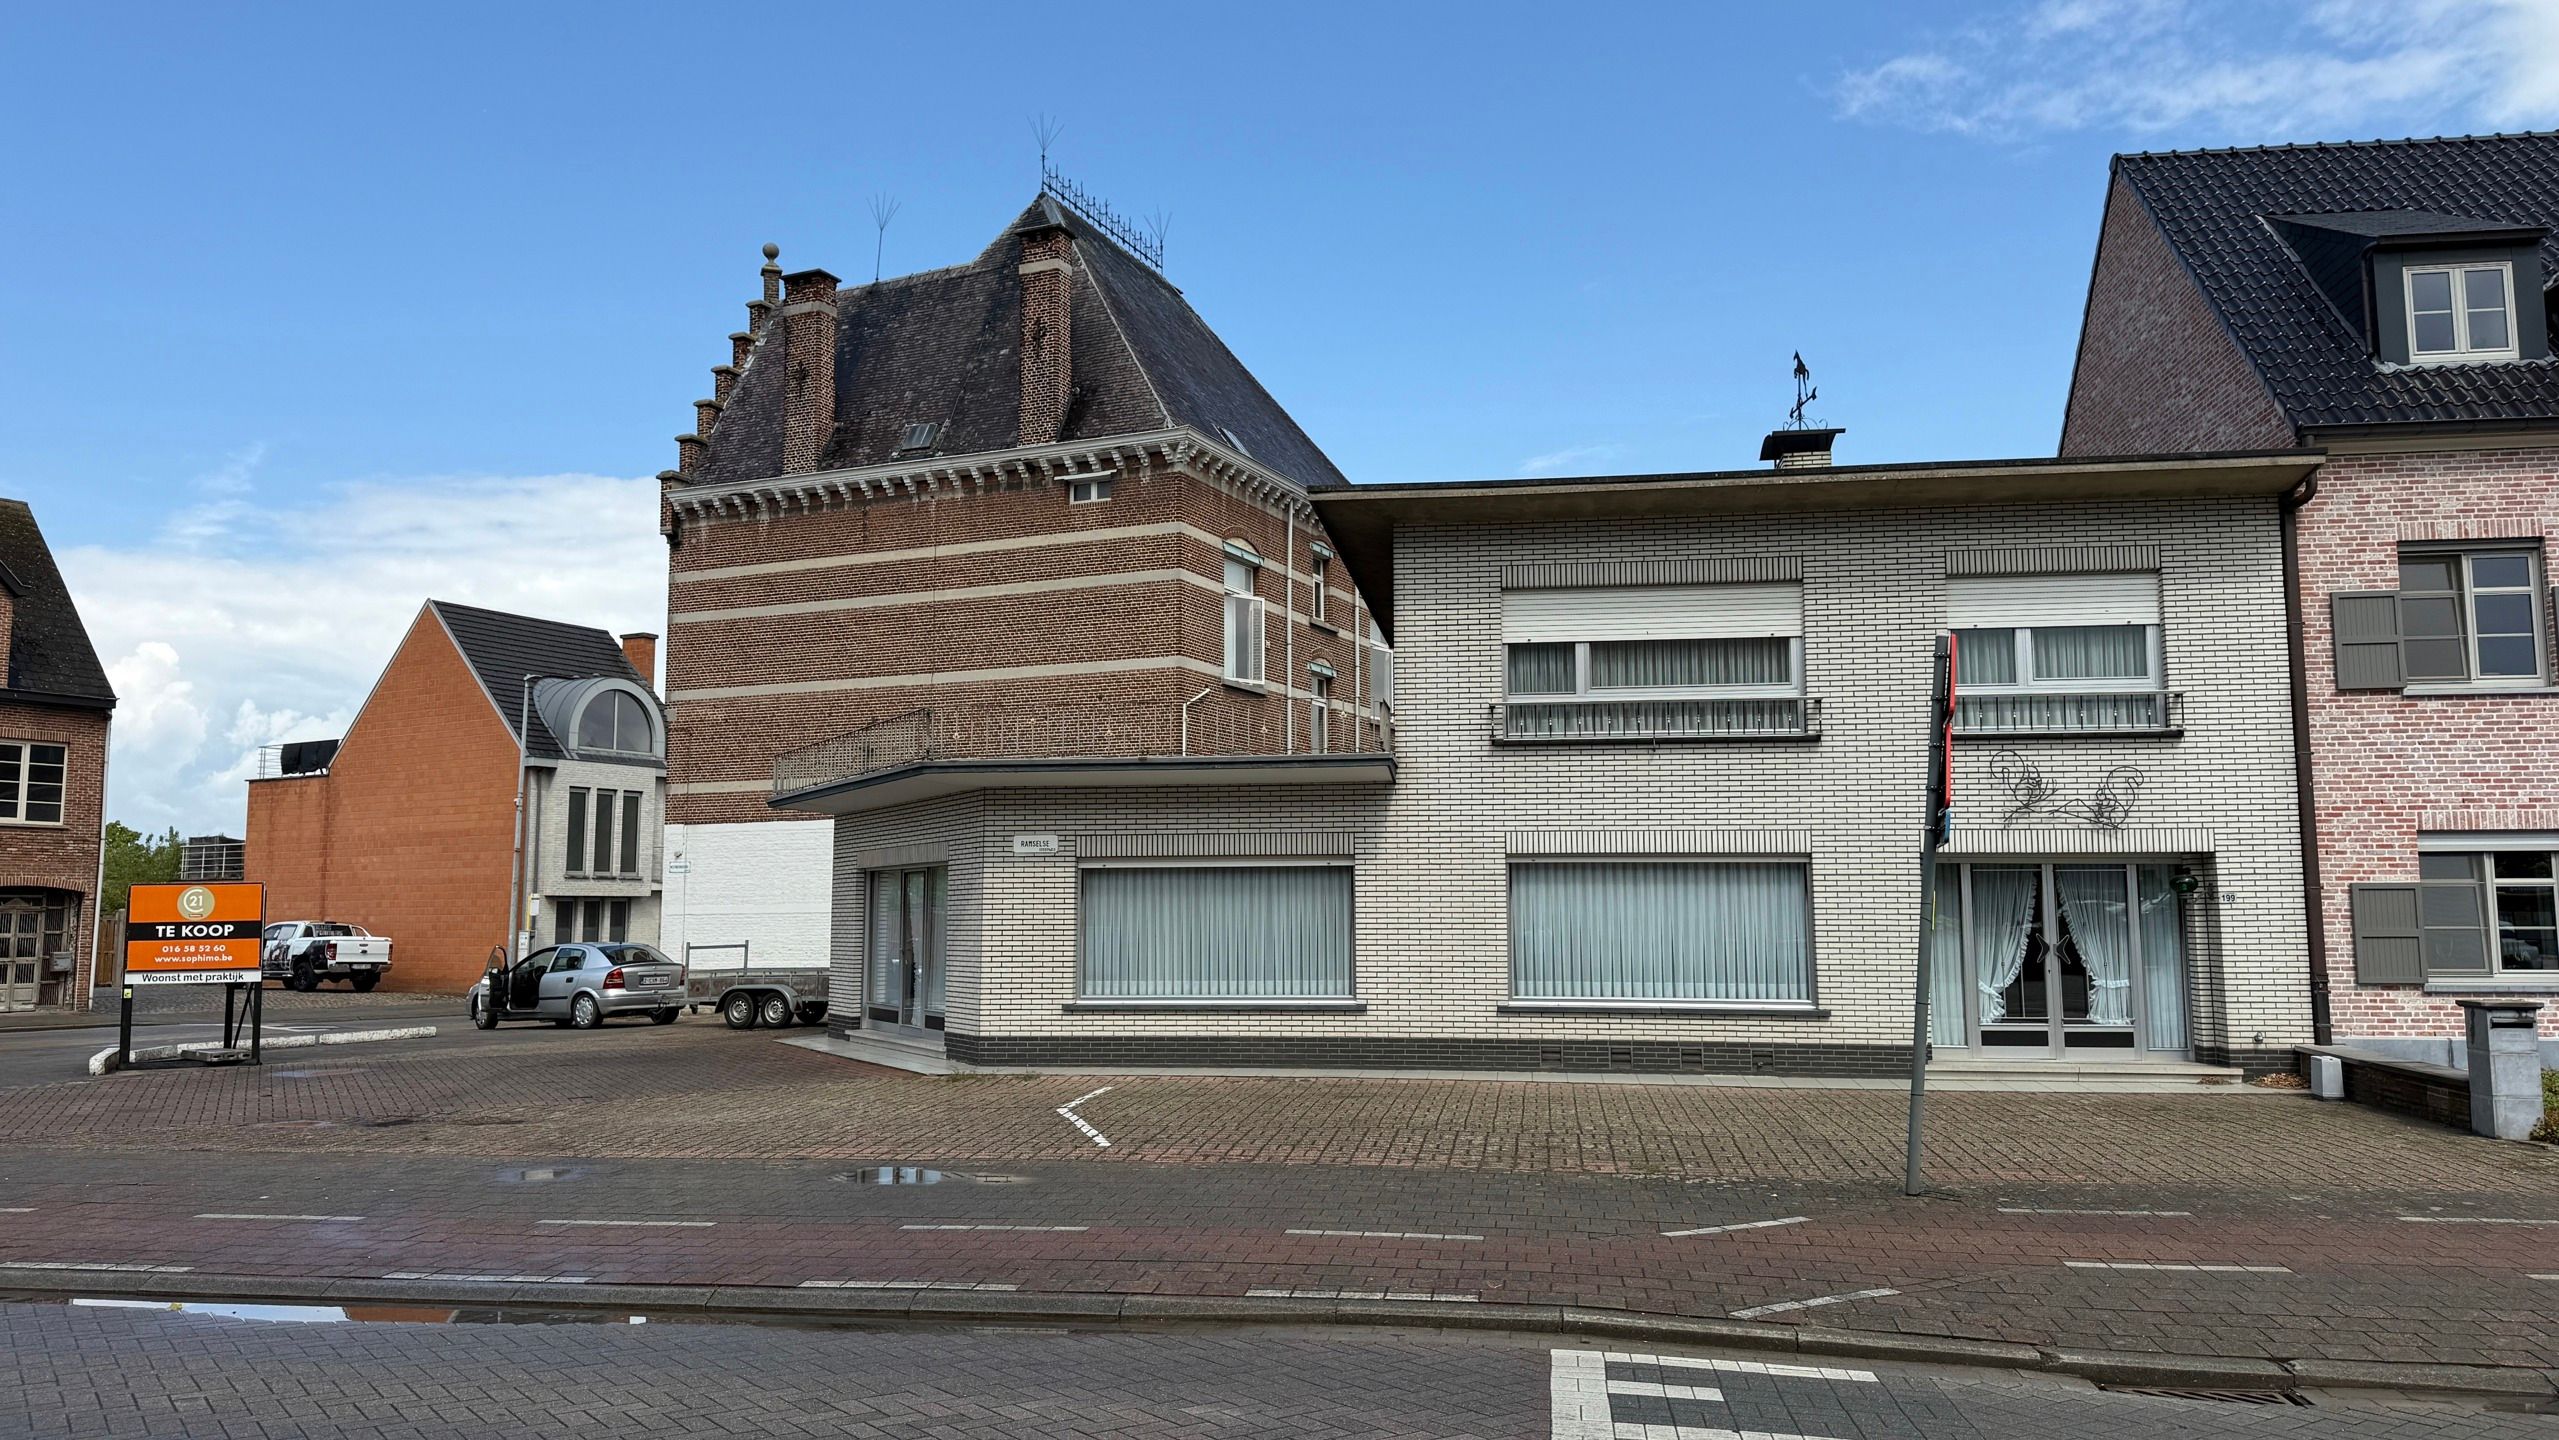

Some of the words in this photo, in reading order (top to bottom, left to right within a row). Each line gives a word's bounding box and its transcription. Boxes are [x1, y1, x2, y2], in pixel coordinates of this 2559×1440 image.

[155, 925, 176, 938] TE
[181, 924, 235, 937] KOOP
[162, 945, 181, 953] 016
[213, 944, 226, 952] 60
[154, 954, 233, 964] www.sophimo.be
[142, 972, 182, 982] Woonst
[183, 972, 204, 982] met
[205, 971, 244, 983] praktijk
